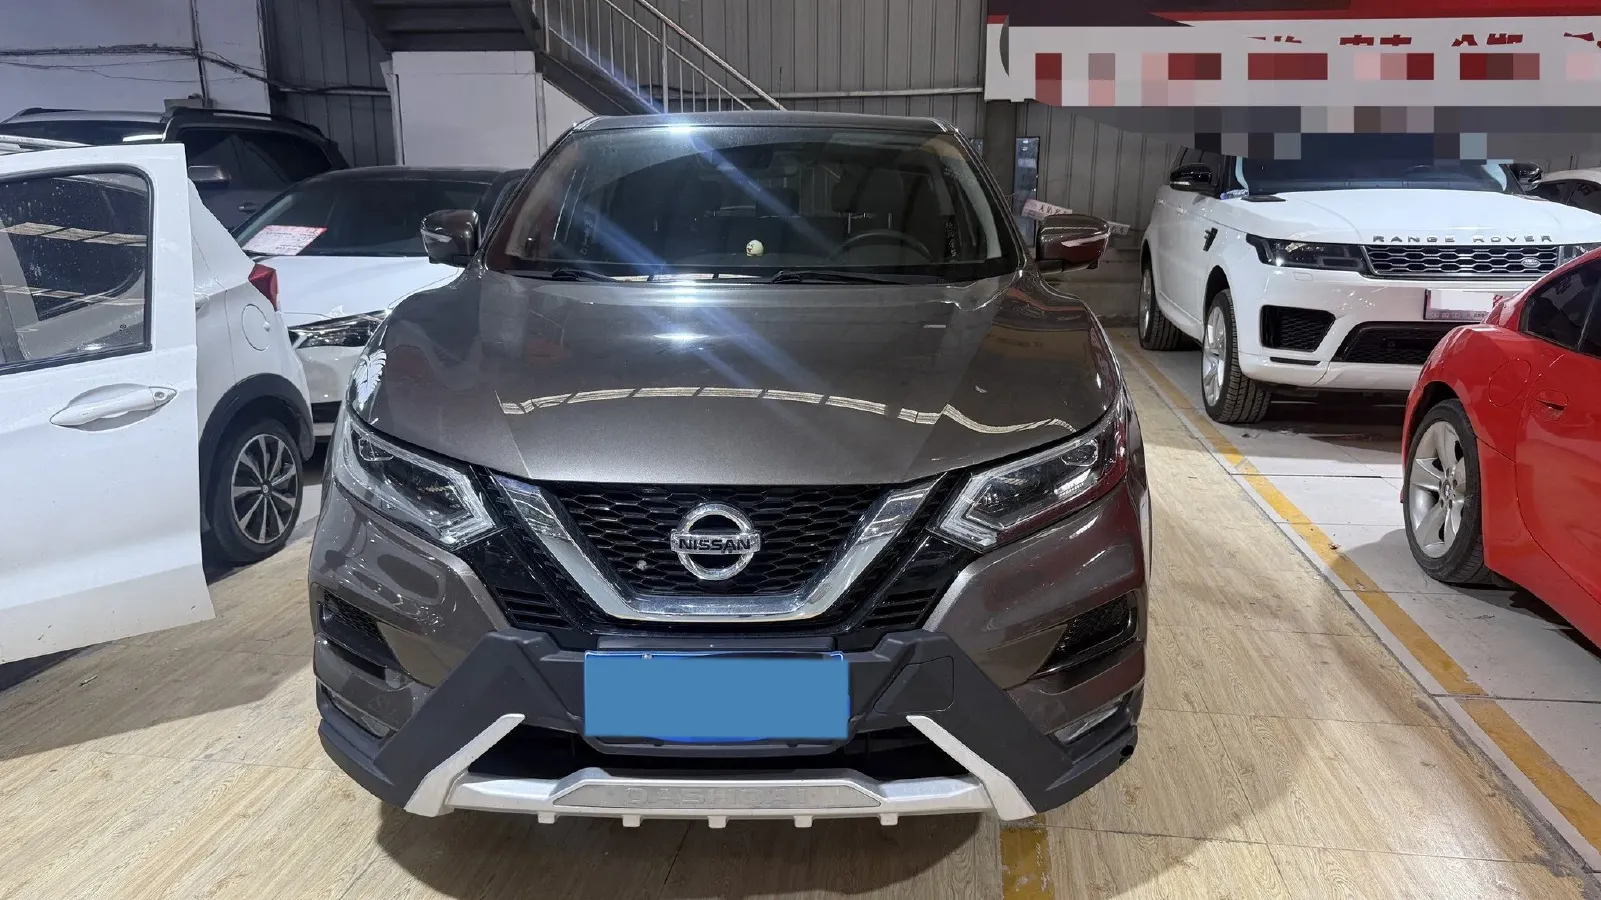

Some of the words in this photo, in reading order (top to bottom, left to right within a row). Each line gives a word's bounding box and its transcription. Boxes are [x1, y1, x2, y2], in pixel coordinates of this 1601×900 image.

[1372, 235, 1456, 243] RANGE
[1472, 235, 1553, 243] ROVER
[678, 538, 751, 552] NISSAN
